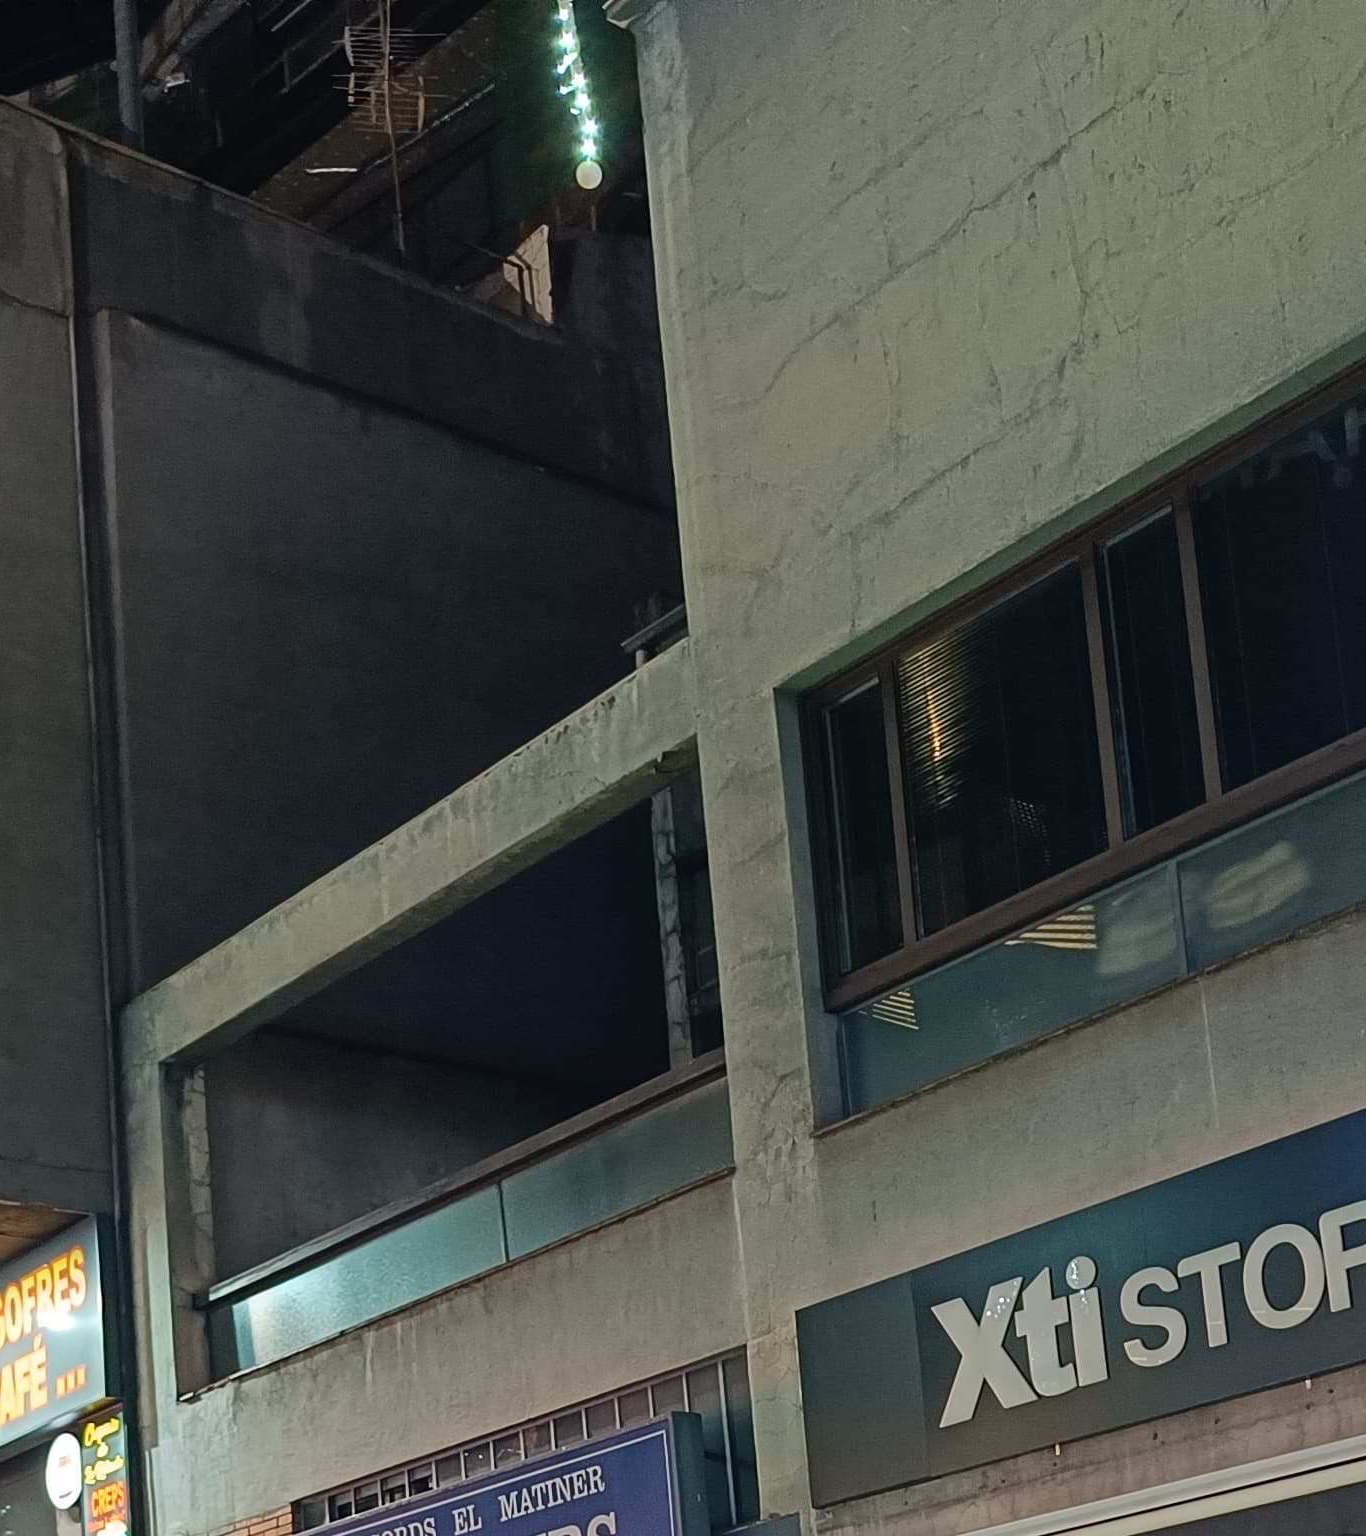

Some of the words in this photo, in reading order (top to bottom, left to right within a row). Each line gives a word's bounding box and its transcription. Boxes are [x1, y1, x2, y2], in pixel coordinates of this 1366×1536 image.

[930, 1255, 1111, 1429] Xti
[90, 1481, 126, 1518] CREPS
[453, 1500, 483, 1533] EL
[499, 1464, 606, 1521] MATINER
